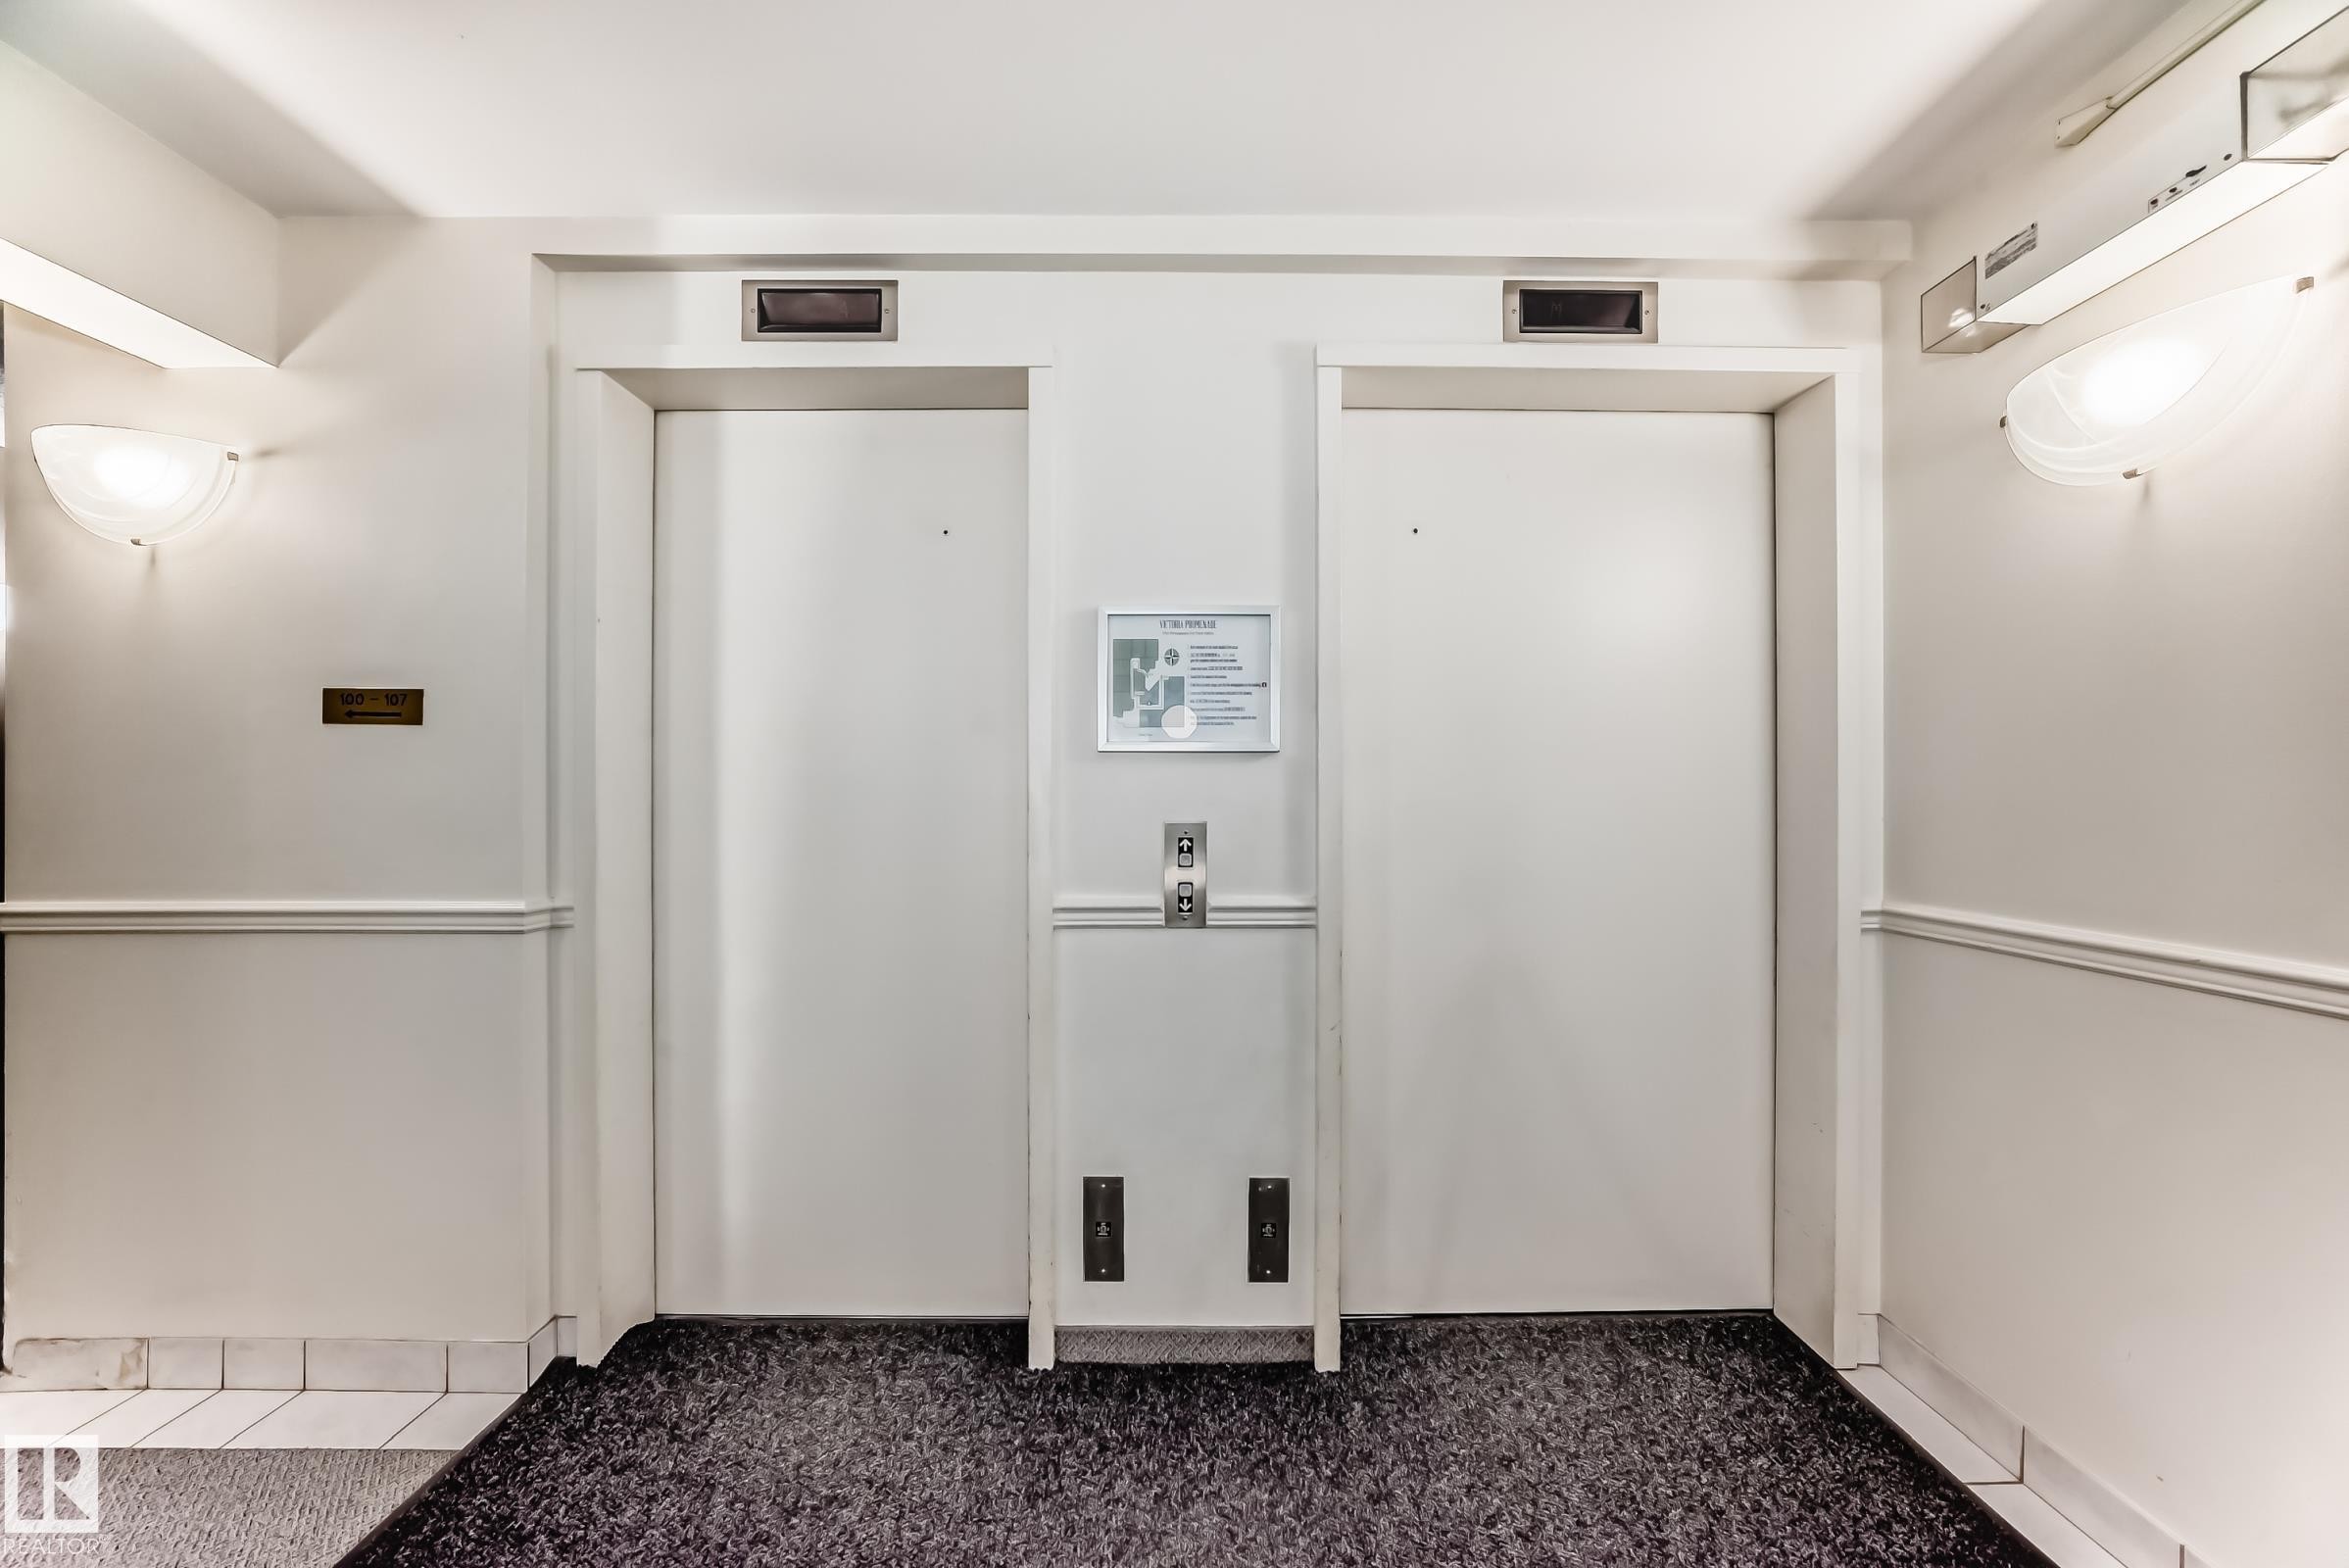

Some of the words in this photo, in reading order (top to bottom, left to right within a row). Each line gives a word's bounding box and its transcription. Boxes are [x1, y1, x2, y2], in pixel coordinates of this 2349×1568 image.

[1185, 619, 1216, 629] PROMENADE
[340, 693, 365, 706] 100
[384, 693, 408, 706] 107
